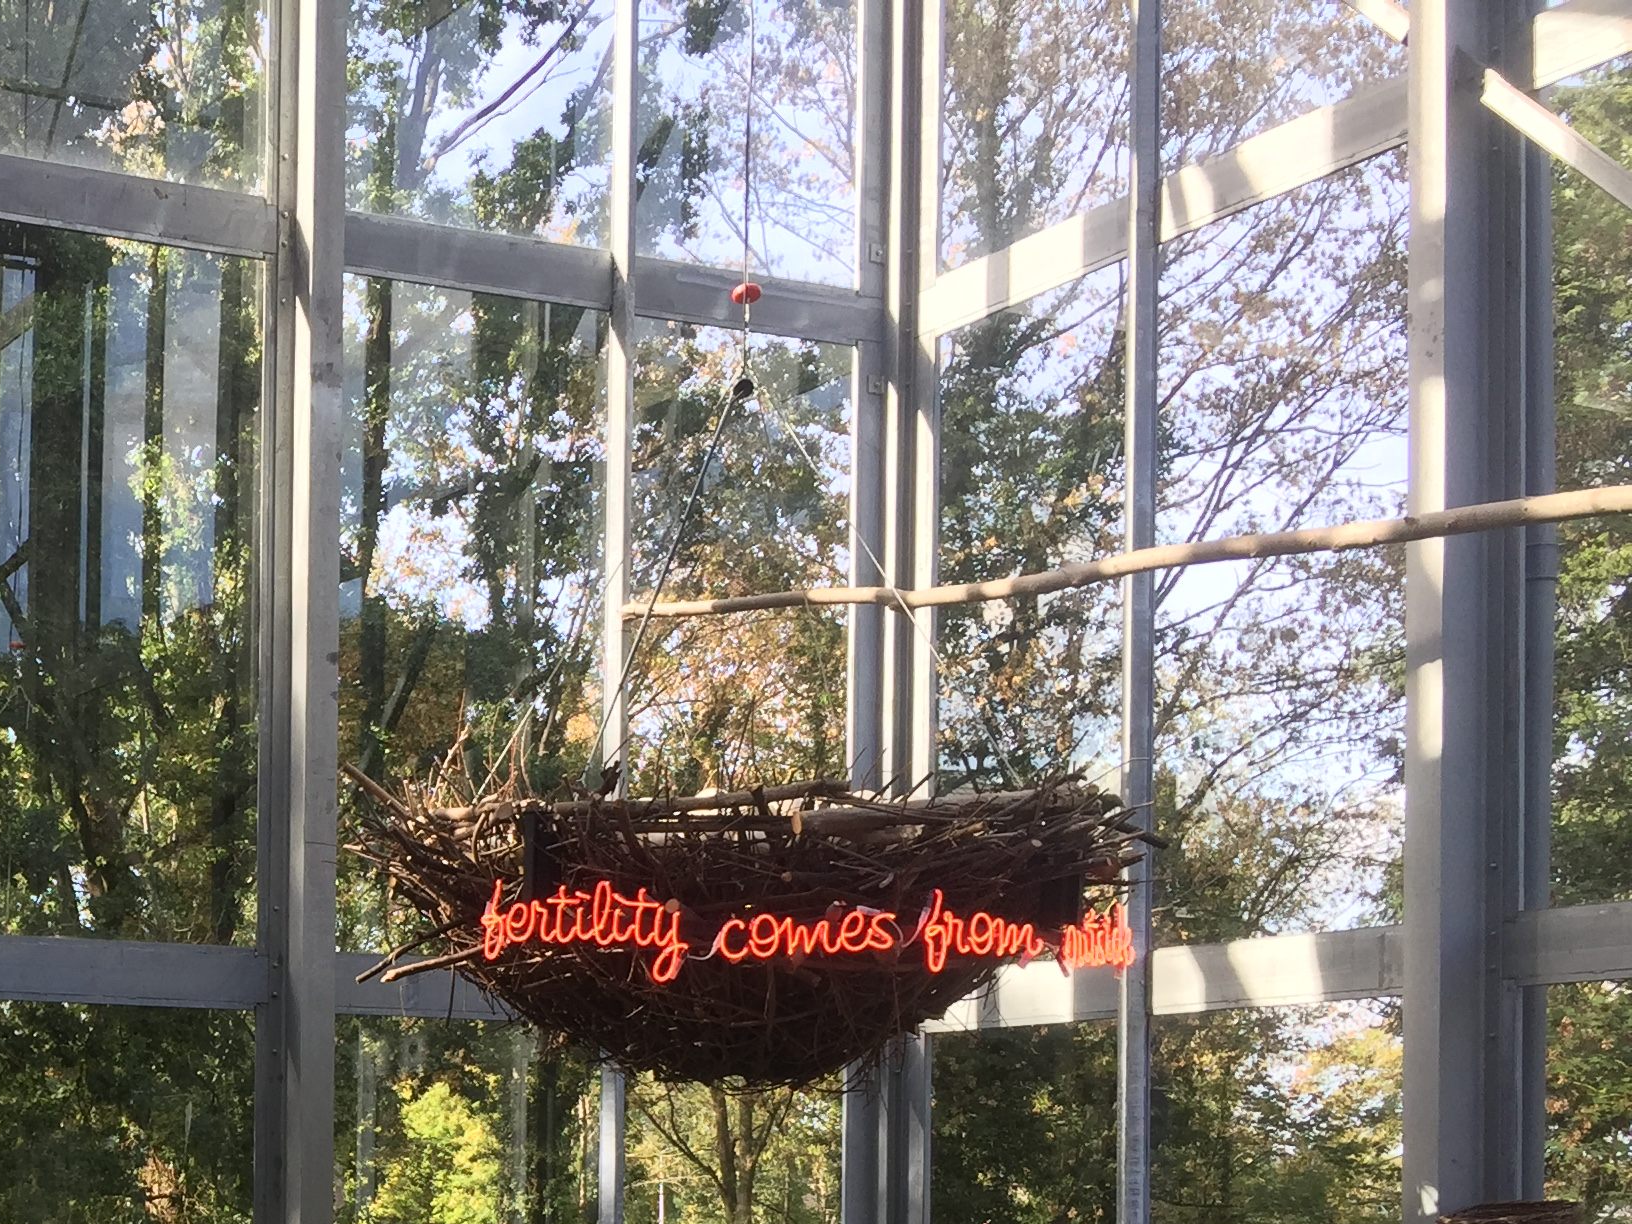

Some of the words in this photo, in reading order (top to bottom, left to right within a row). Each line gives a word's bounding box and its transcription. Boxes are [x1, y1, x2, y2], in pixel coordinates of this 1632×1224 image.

[480, 879, 689, 983] fertility
[719, 911, 896, 960] comes
[923, 888, 1044, 973] from
